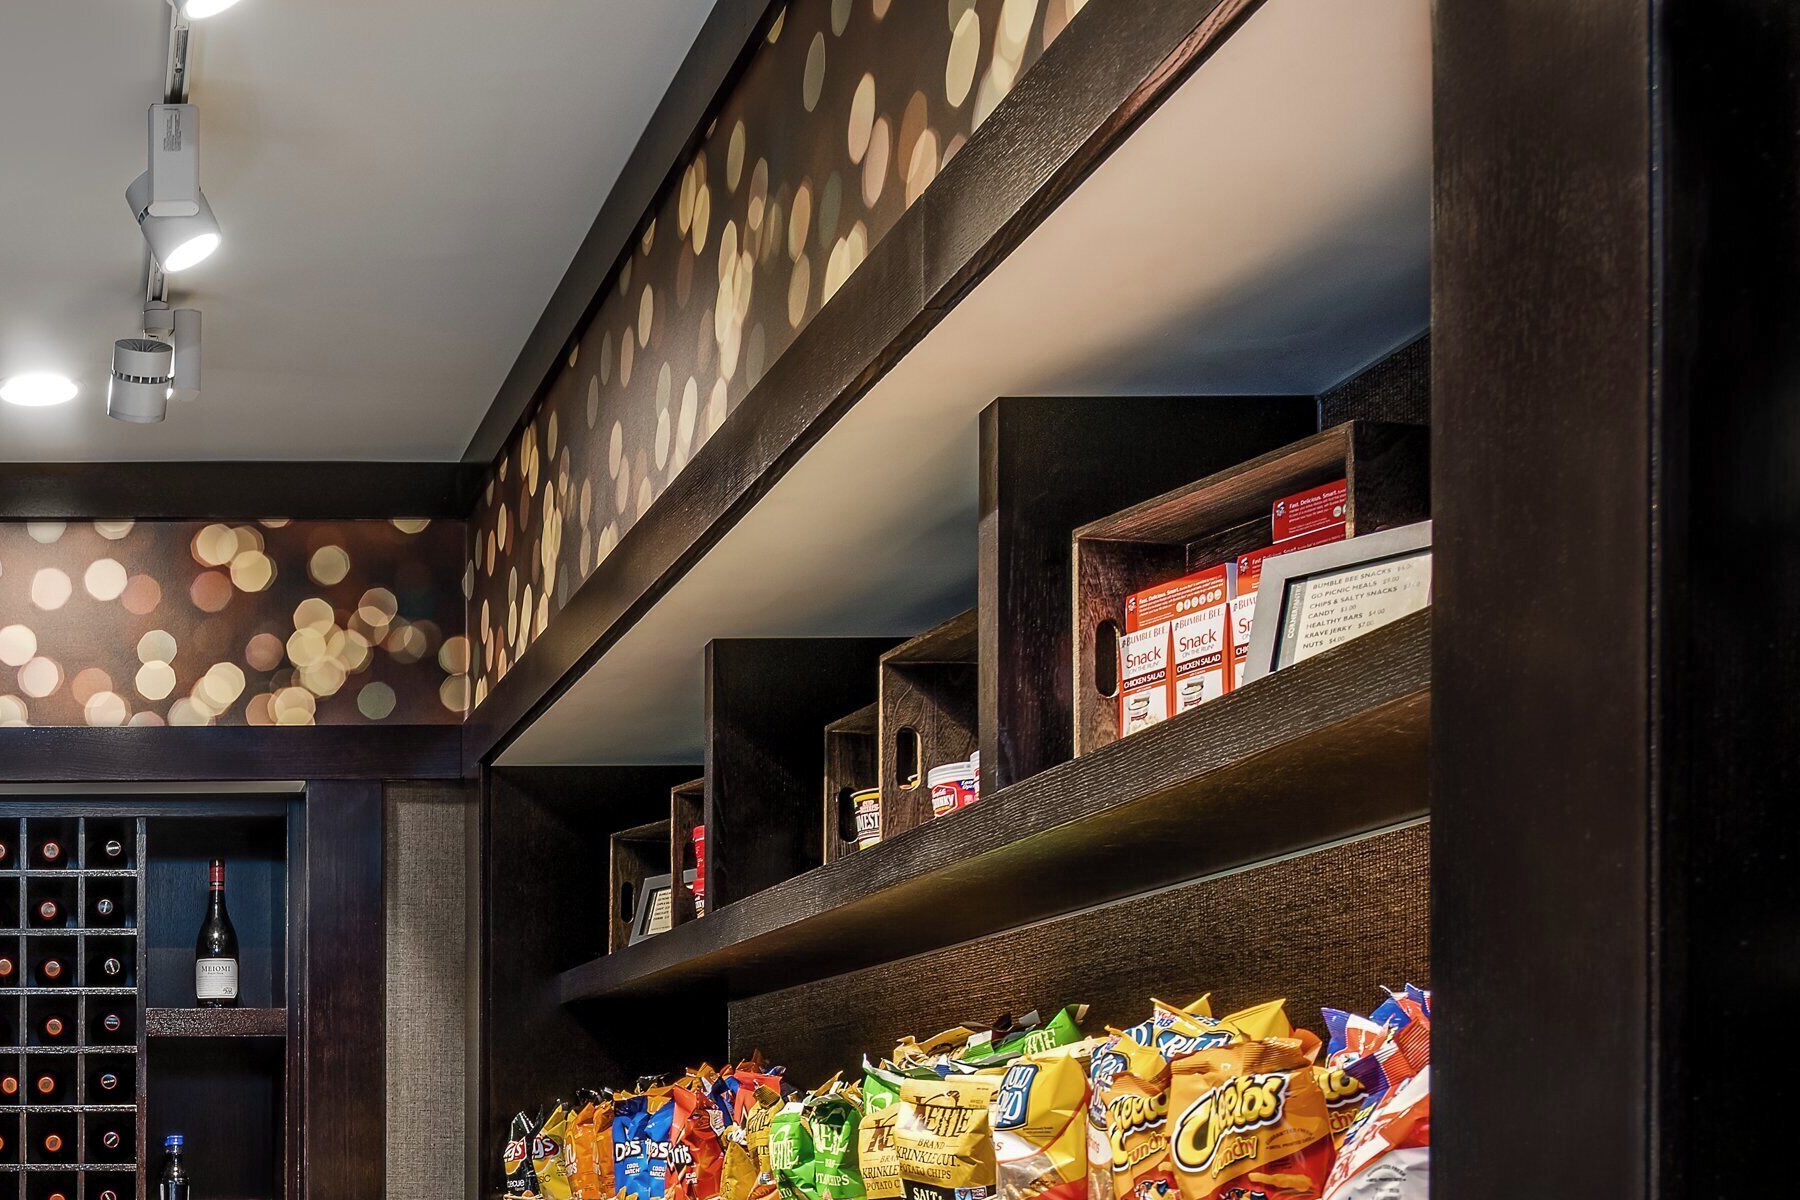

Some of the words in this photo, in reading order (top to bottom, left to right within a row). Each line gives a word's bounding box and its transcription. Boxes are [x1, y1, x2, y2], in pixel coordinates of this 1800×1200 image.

[1312, 578, 1342, 590] BUMBLE
[1344, 573, 1359, 583] BEE
[1360, 567, 1392, 579] SNACKS
[1309, 600, 1332, 609] CHIPS
[1340, 592, 1364, 603] SALTY
[1366, 586, 1398, 597] SNACKS
[1311, 592, 1323, 600] GO
[1325, 587, 1350, 598] PICNIC
[1352, 580, 1377, 591] MEALS
[1306, 618, 1342, 630] HEALTHY
[1343, 612, 1363, 622] BARS
[1308, 608, 1335, 620] CANDY
[1179, 628, 1217, 653] Snack
[1304, 629, 1329, 639] KRAVE
[1330, 624, 1353, 635] JERKY
[1302, 640, 1324, 650] NUTS
[1126, 646, 1162, 669] Snack
[1176, 660, 1201, 674] CHICKEN
[1200, 653, 1221, 667] SALAD
[1123, 675, 1147, 689] CHICKEN
[1146, 670, 1166, 682] SALAD
[1176, 1072, 1286, 1168] Cheetos
[917, 1139, 946, 1150] BRAND
[926, 1167, 951, 1180] CHIPS
[865, 1179, 896, 1192] POTATO
